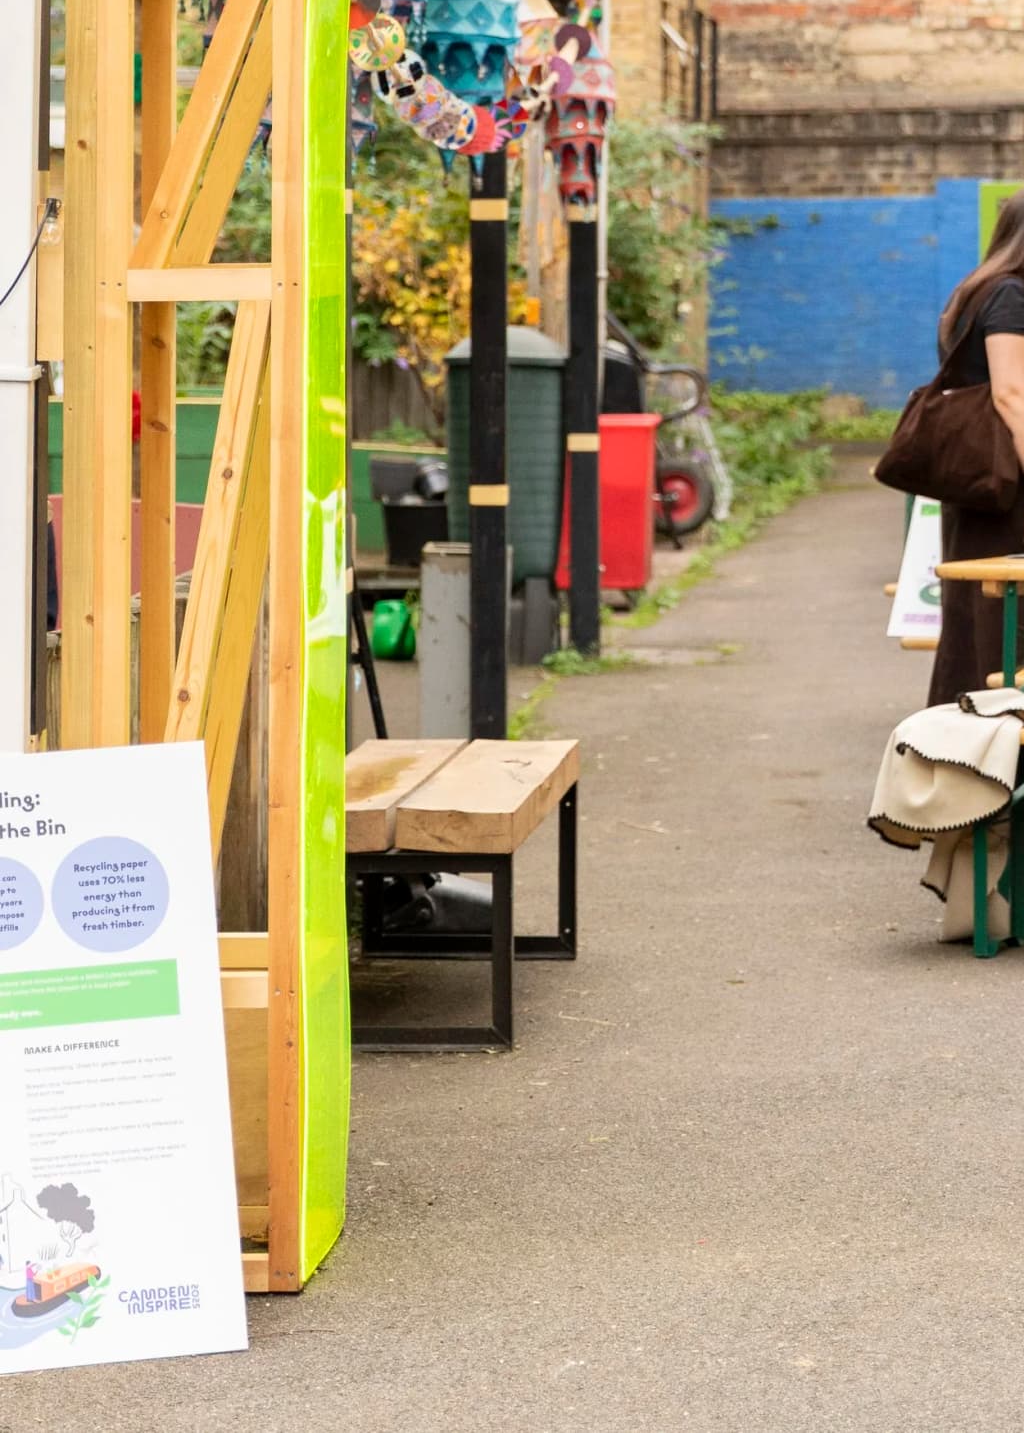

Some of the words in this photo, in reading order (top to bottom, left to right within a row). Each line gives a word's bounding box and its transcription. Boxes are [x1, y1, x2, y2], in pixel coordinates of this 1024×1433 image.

[36, 818, 66, 836] Bin
[73, 862, 119, 873] Recycling
[120, 860, 148, 871] paper
[78, 879, 100, 887] uses
[102, 875, 125, 885] 70%
[126, 874, 145, 883] less
[83, 892, 117, 903] energy
[118, 889, 142, 899] than
[72, 906, 121, 920] producing
[121, 904, 130, 913] it
[132, 903, 155, 913] from
[82, 921, 108, 931] fresh
[110, 919, 145, 929] timber.
[24, 1045, 52, 1055] MAKE
[54, 1044, 61, 1053] A
[63, 1039, 120, 1052] DIFFERENCE
[118, 1285, 190, 1303] CAMDEN
[128, 1297, 191, 1315] INSPIRE
